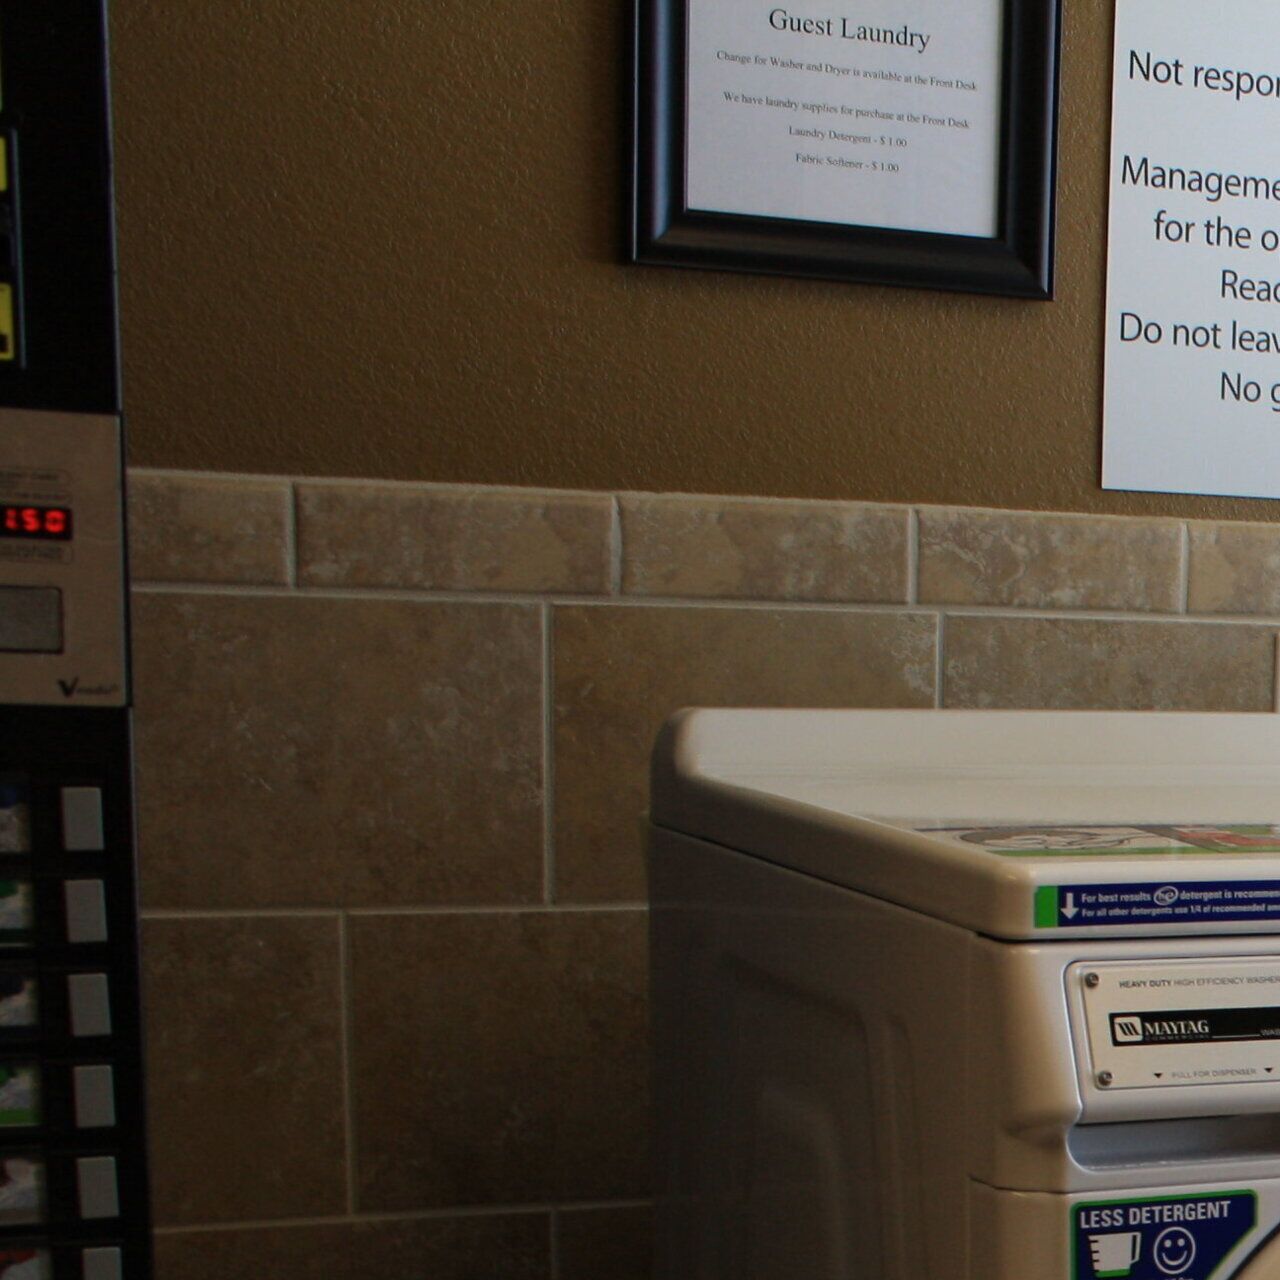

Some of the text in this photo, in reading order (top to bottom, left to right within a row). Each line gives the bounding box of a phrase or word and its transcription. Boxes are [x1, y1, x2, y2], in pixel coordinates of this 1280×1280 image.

[768, 8, 931, 54] Guest Laundry
[716, 50, 976, 91] Change for Washer and Dryer is available at the Front Desk
[1128, 48, 1184, 86] Not
[723, 91, 969, 128] We have laundry supplies for purchase at the Front Desk
[788, 125, 908, 148] Laundry Detergent $ 1.00
[795, 152, 900, 173] Fabric Softener $ 1.00
[1152, 208, 1196, 244] for
[1202, 214, 1252, 250] the
[1119, 311, 1163, 344] Do
[1172, 322, 1222, 350] not
[1220, 370, 1262, 403] No
[1143, 1019, 1210, 1036] MAYTAG
[1080, 1200, 1231, 1229] LESS DETERGENT
